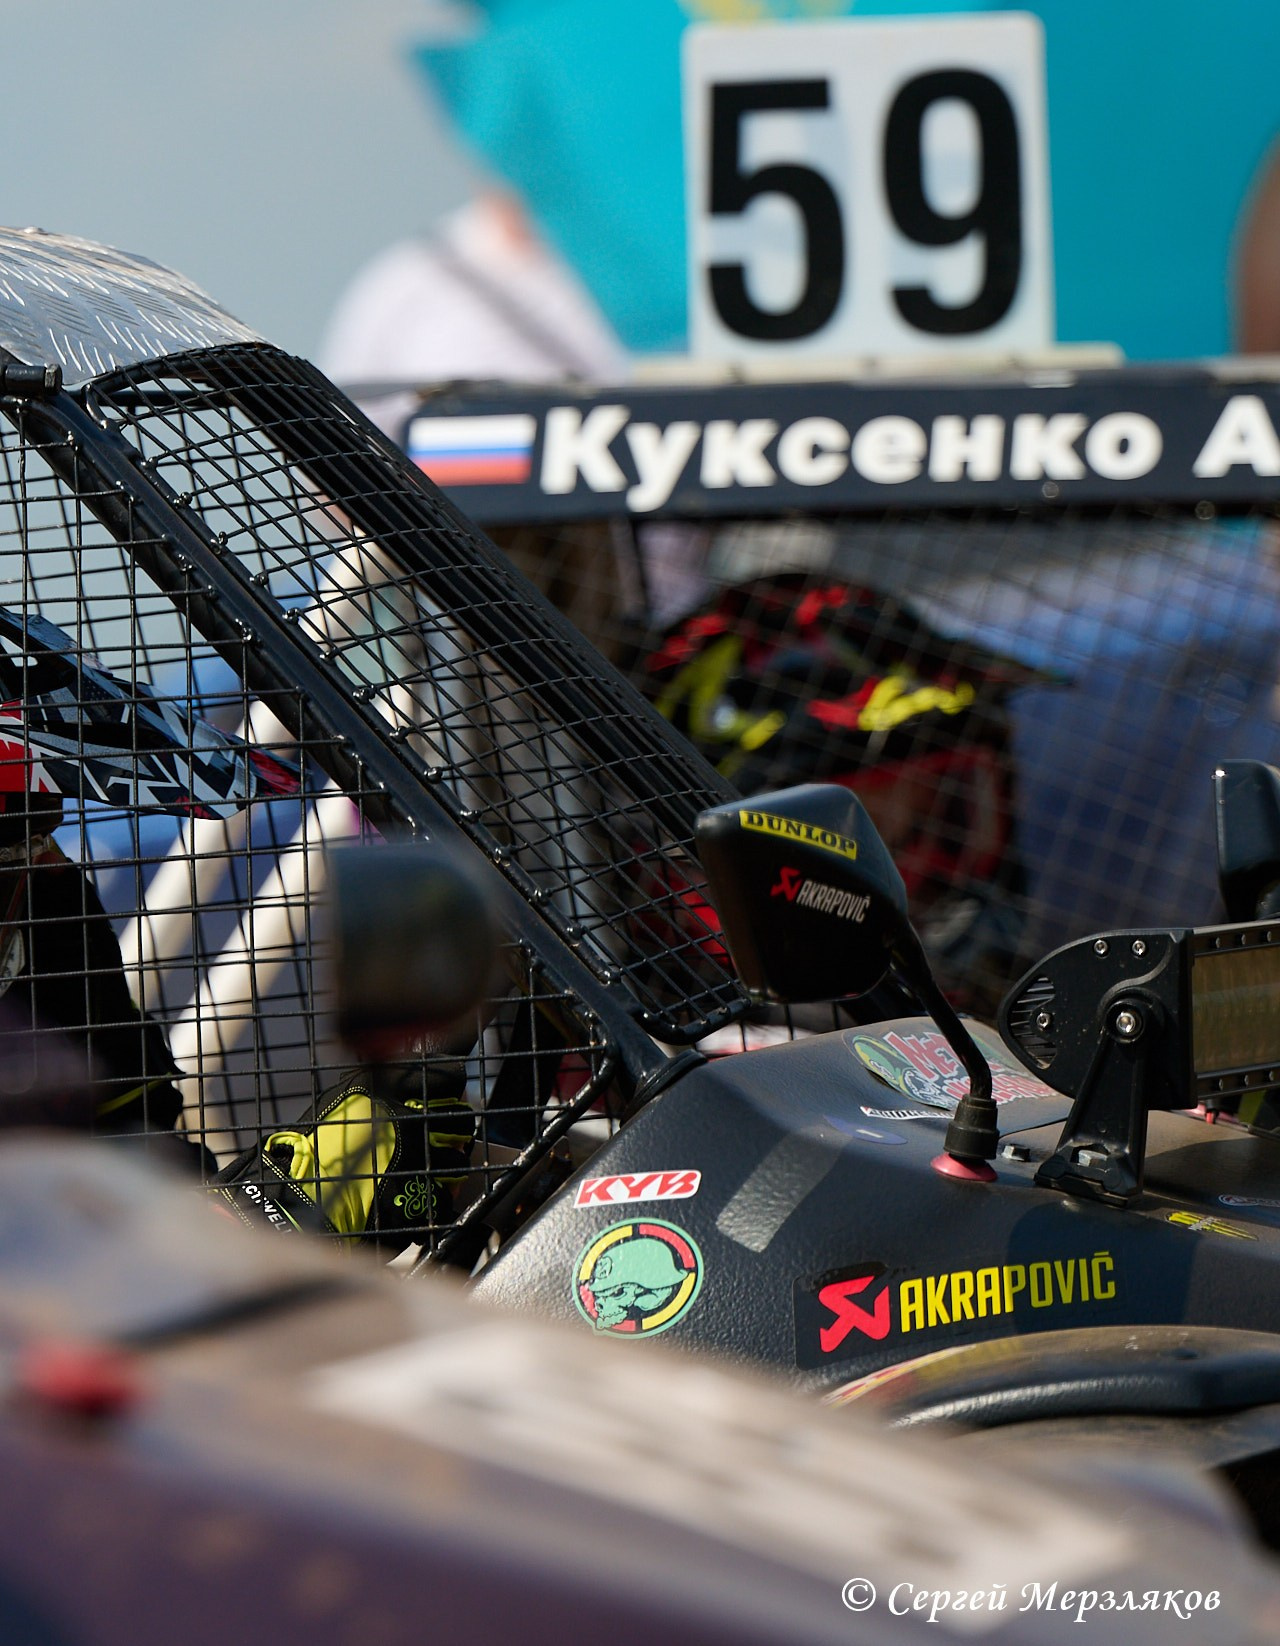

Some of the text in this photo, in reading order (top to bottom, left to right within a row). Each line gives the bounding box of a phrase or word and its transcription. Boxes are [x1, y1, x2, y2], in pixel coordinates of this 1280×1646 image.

[705, 68, 1024, 343] 59
[540, 404, 1163, 512] Куксенко
[744, 811, 855, 854] DUNLOP
[577, 1171, 698, 1205] KYB
